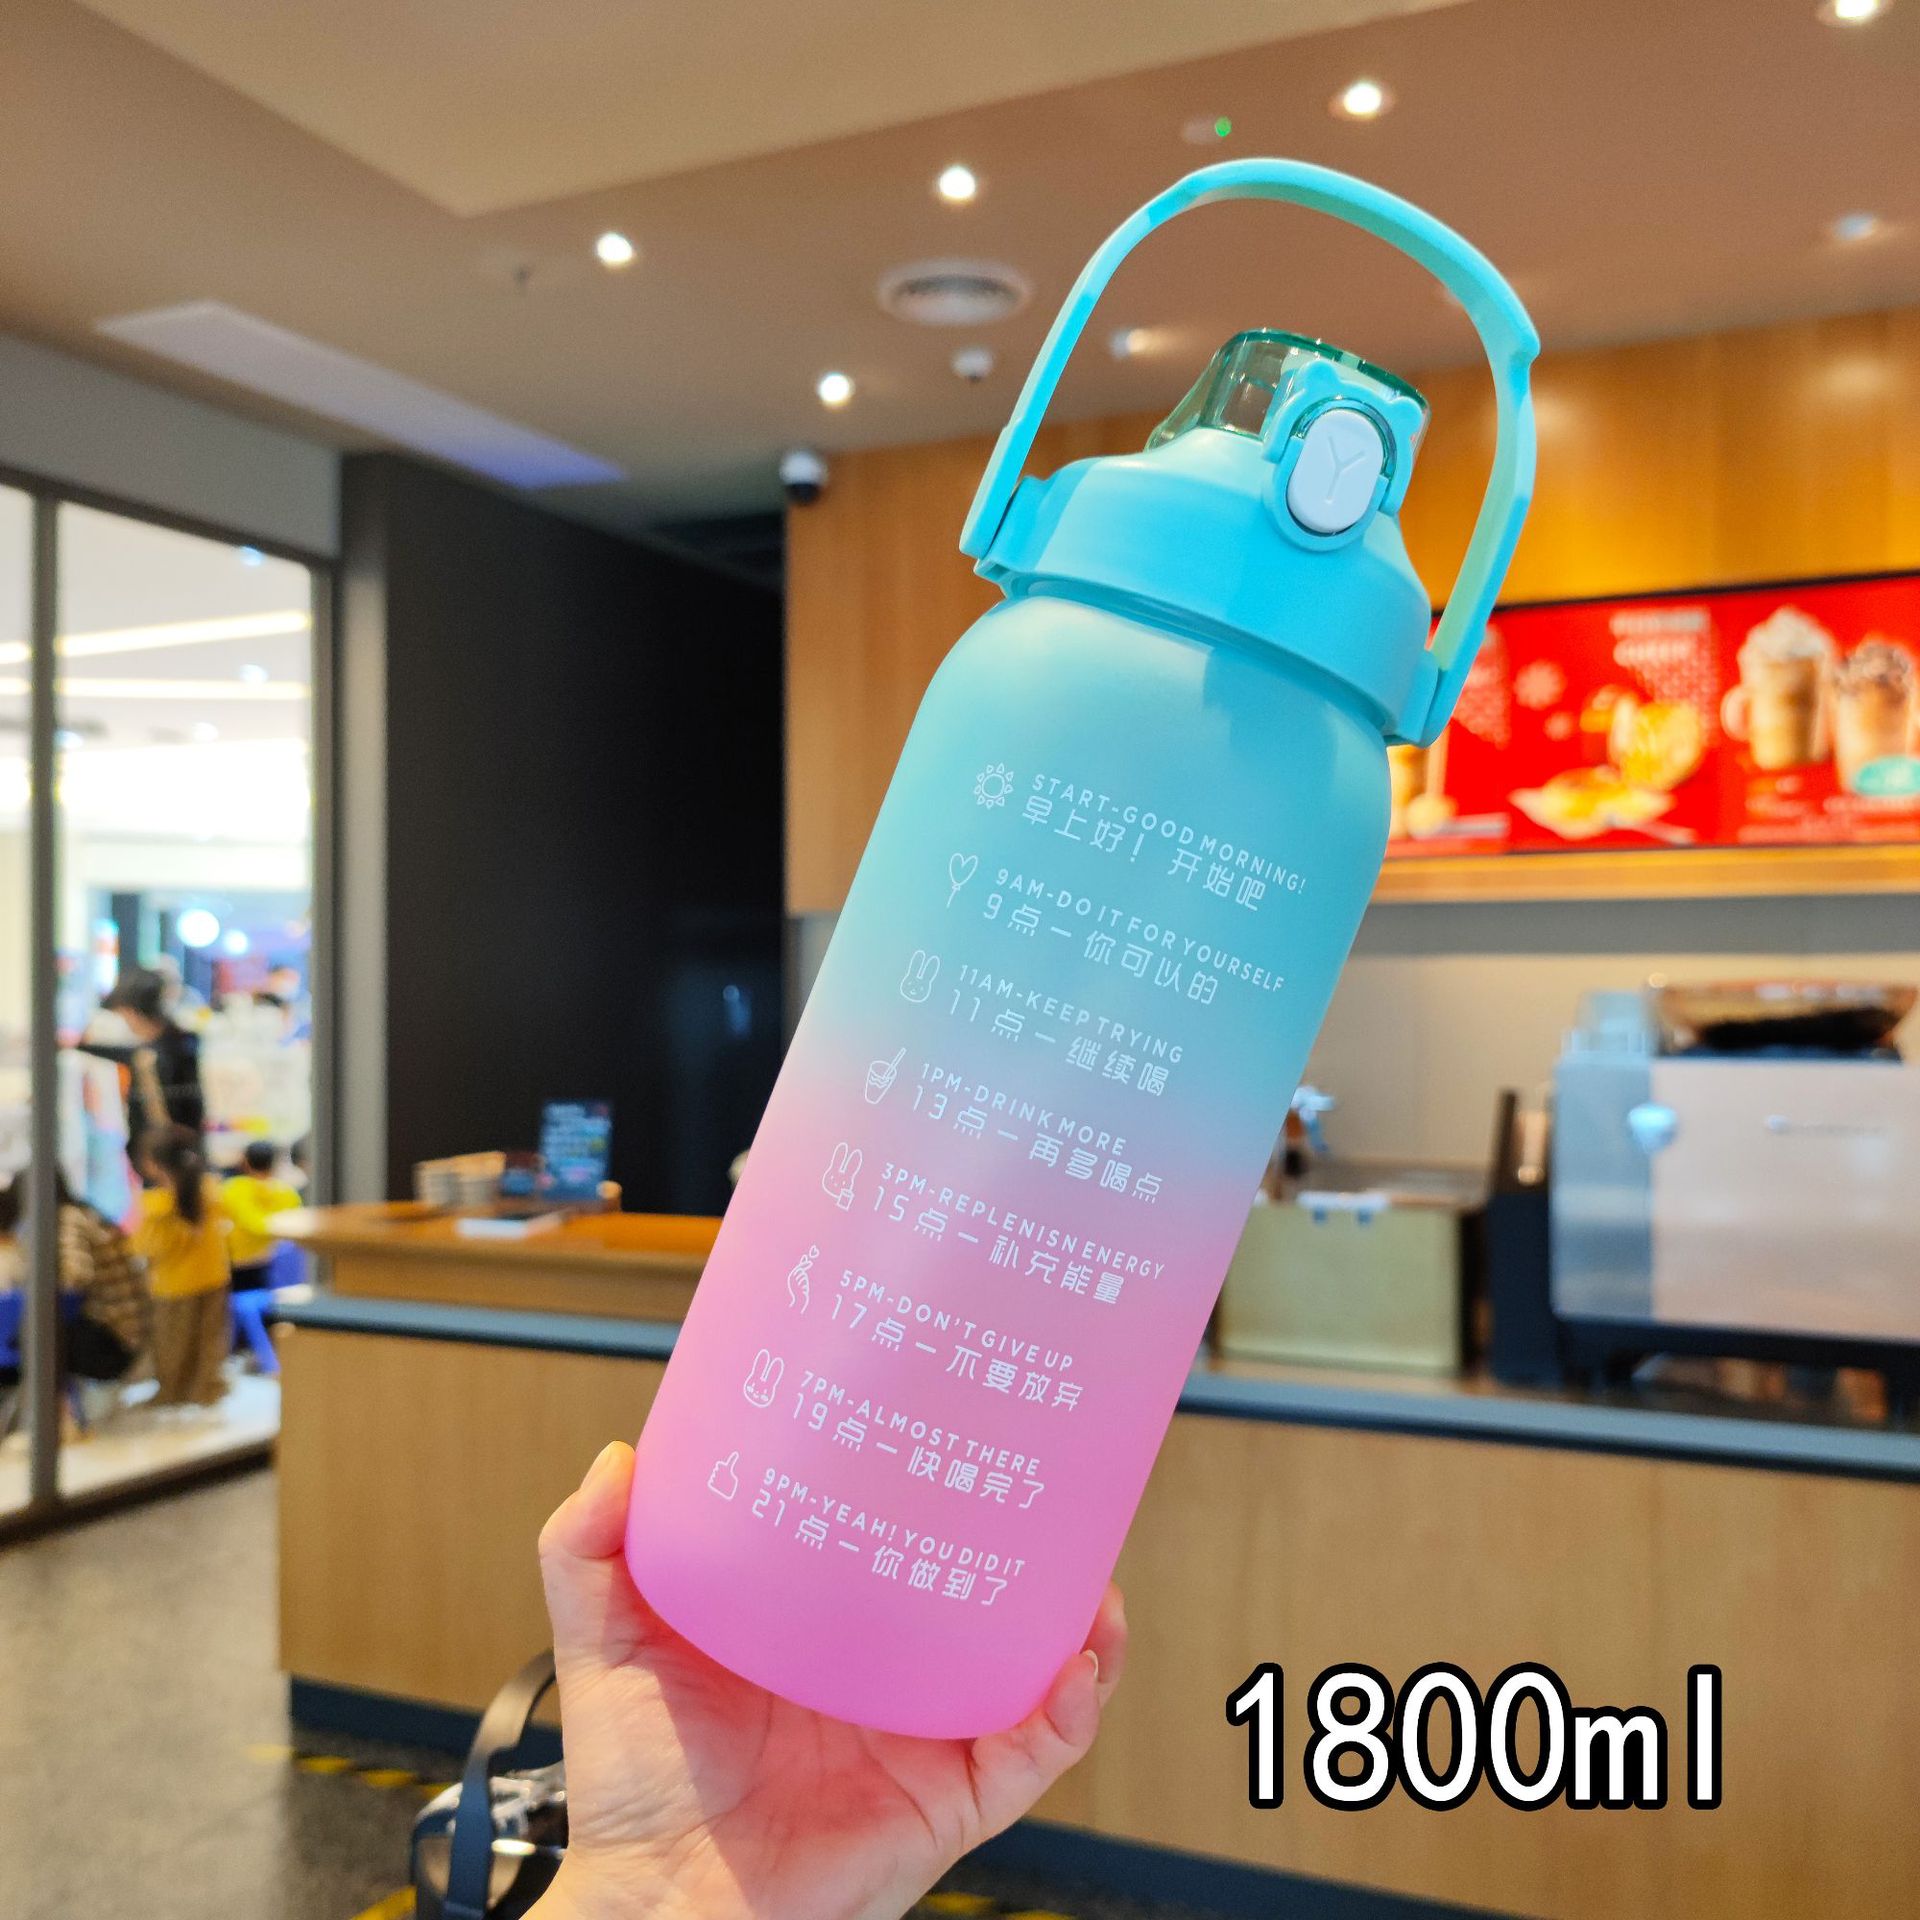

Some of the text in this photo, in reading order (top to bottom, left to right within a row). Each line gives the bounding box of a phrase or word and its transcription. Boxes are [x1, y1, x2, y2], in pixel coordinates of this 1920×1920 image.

[1032, 774, 1307, 894] START-GOOD MORNING!
[996, 869, 1285, 992] 9AM-DO IT FOR YOURSELF
[959, 964, 1183, 1064] 11AM-KEEP TRYING
[921, 1063, 1126, 1156] 1PM-DRINK MORE
[881, 1162, 1166, 1280] 3PM-REPLENISN ENERGY
[840, 1270, 1073, 1372] 5PM-DON'T GIVE UP
[801, 1370, 1041, 1476] 7PM-ALMOST THERE
[763, 1468, 1025, 1577] 9PM-YEAH! YOU DID IT
